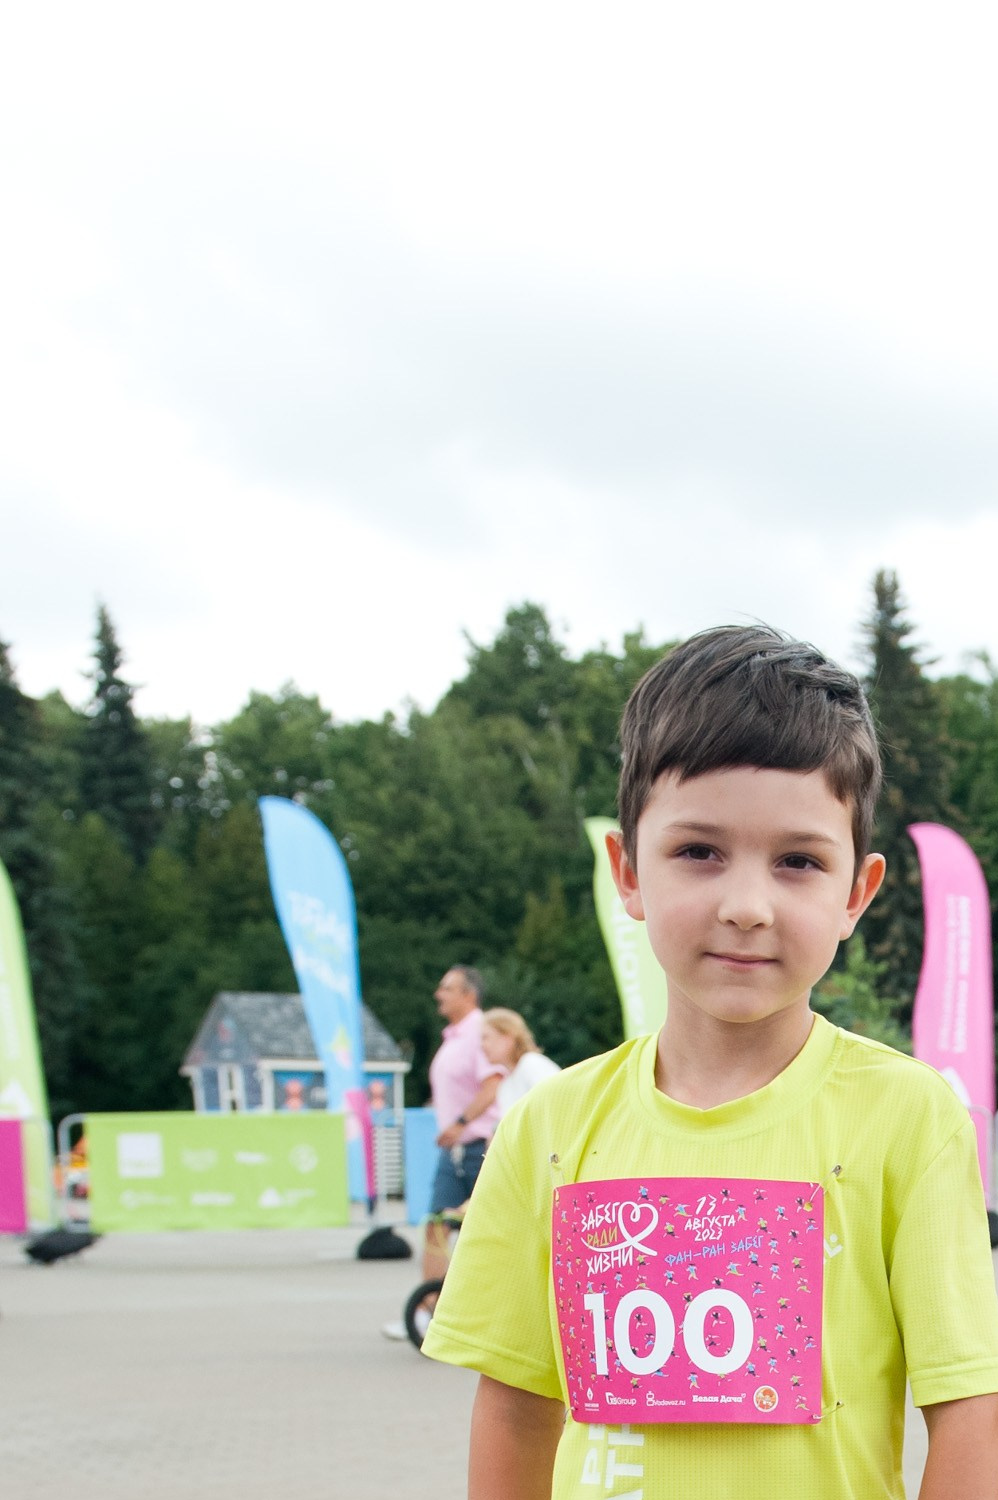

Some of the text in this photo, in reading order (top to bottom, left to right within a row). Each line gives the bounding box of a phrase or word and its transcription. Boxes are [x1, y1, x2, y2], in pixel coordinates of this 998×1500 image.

[696, 1194, 717, 1215] 13
[581, 1202, 620, 1232] ЗАБЕГ
[684, 1215, 736, 1231] АВГУСТА
[587, 1226, 618, 1247] РАДИ
[694, 1227, 723, 1241] 2023
[730, 1235, 764, 1254] ЗАБЕГ
[584, 1288, 754, 1375] 100
